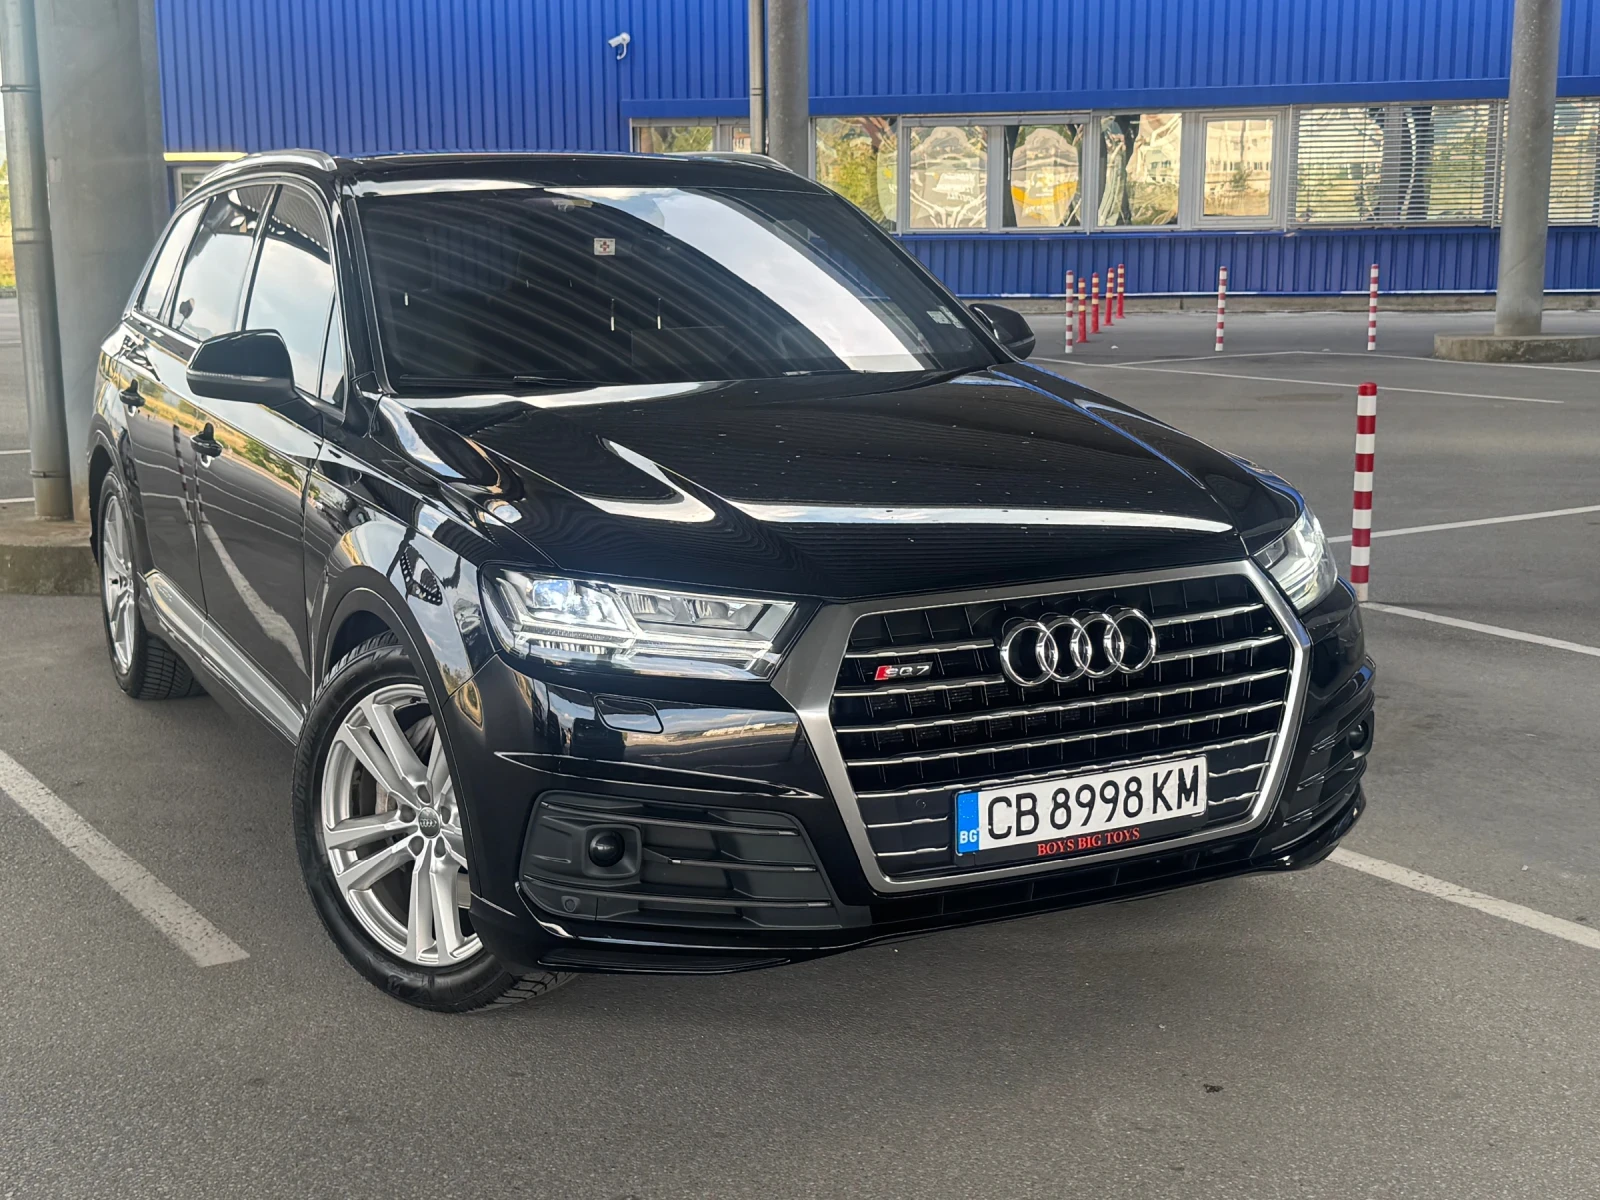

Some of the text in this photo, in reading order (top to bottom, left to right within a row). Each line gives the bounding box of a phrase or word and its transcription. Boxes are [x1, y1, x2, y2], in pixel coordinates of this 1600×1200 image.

[880, 665, 930, 679] SQ7
[1050, 776, 1143, 830] 8998
[959, 829, 978, 844] BG
[1037, 828, 1140, 856] BOYS BIG TOYS
